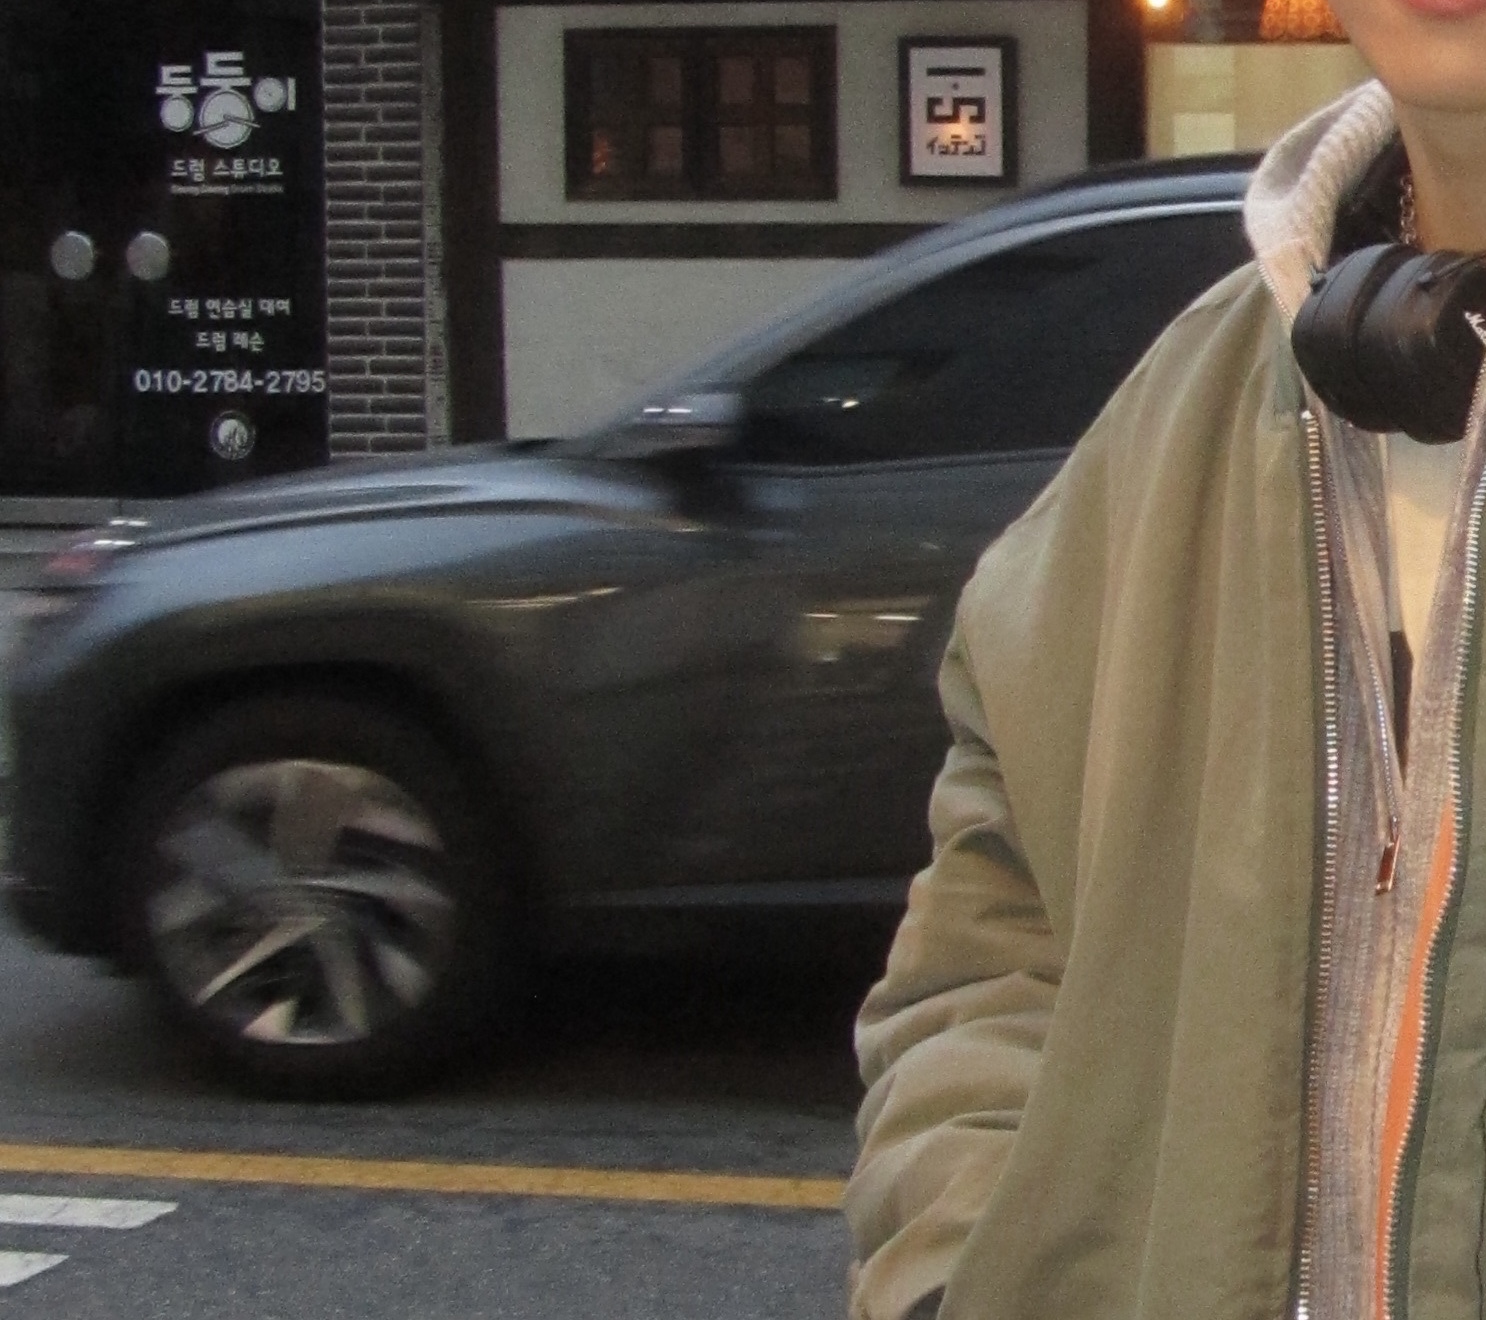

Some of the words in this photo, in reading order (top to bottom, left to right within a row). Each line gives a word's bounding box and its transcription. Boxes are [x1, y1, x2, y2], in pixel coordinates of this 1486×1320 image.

[170, 157, 206, 182] 드럼
[212, 157, 284, 179] 스튜디오
[168, 298, 199, 319] 드럼
[205, 298, 253, 320] 연습실
[258, 298, 291, 316] 대여
[195, 331, 227, 352] 드럼
[232, 331, 265, 352] 레슨
[135, 368, 326, 394] 010-2784-2795
